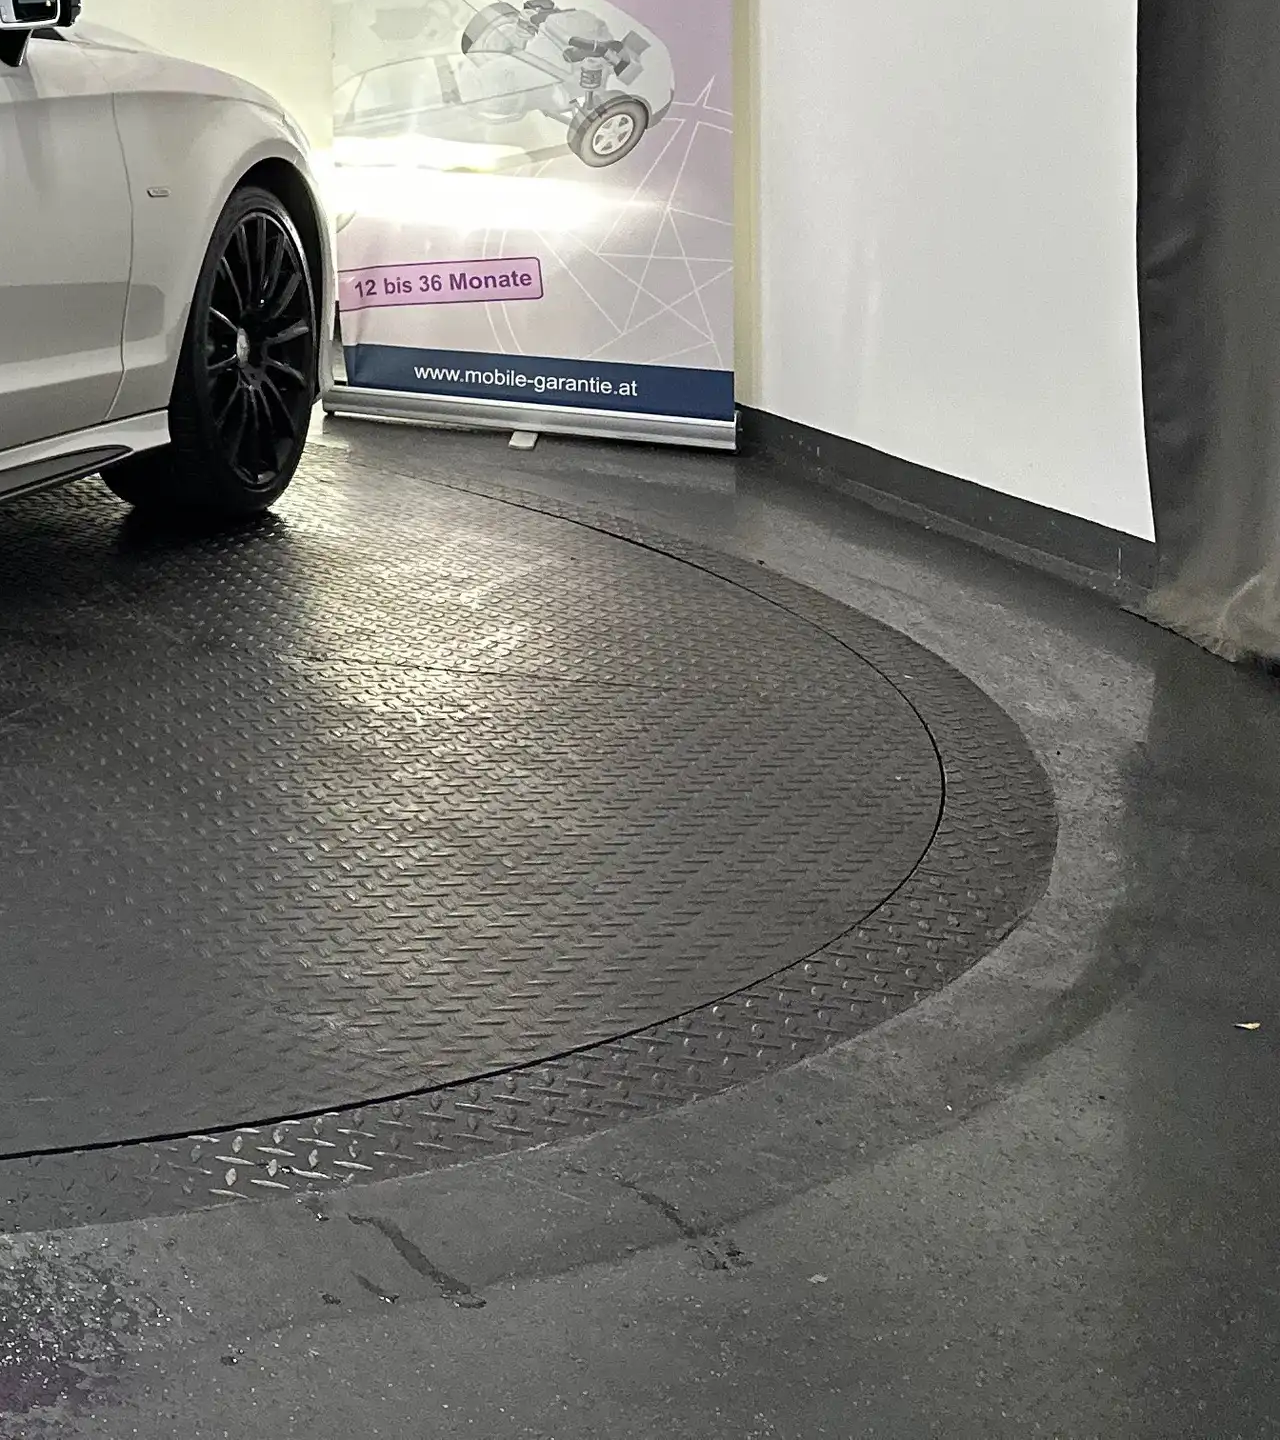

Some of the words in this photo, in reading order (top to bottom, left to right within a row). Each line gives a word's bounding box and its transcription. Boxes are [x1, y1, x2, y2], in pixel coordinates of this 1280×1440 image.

[354, 278, 378, 298] 12
[384, 276, 413, 295] bis
[419, 274, 443, 292] 36
[449, 270, 533, 291] Monate
[413, 365, 638, 398] www.mobile-garantie.at
